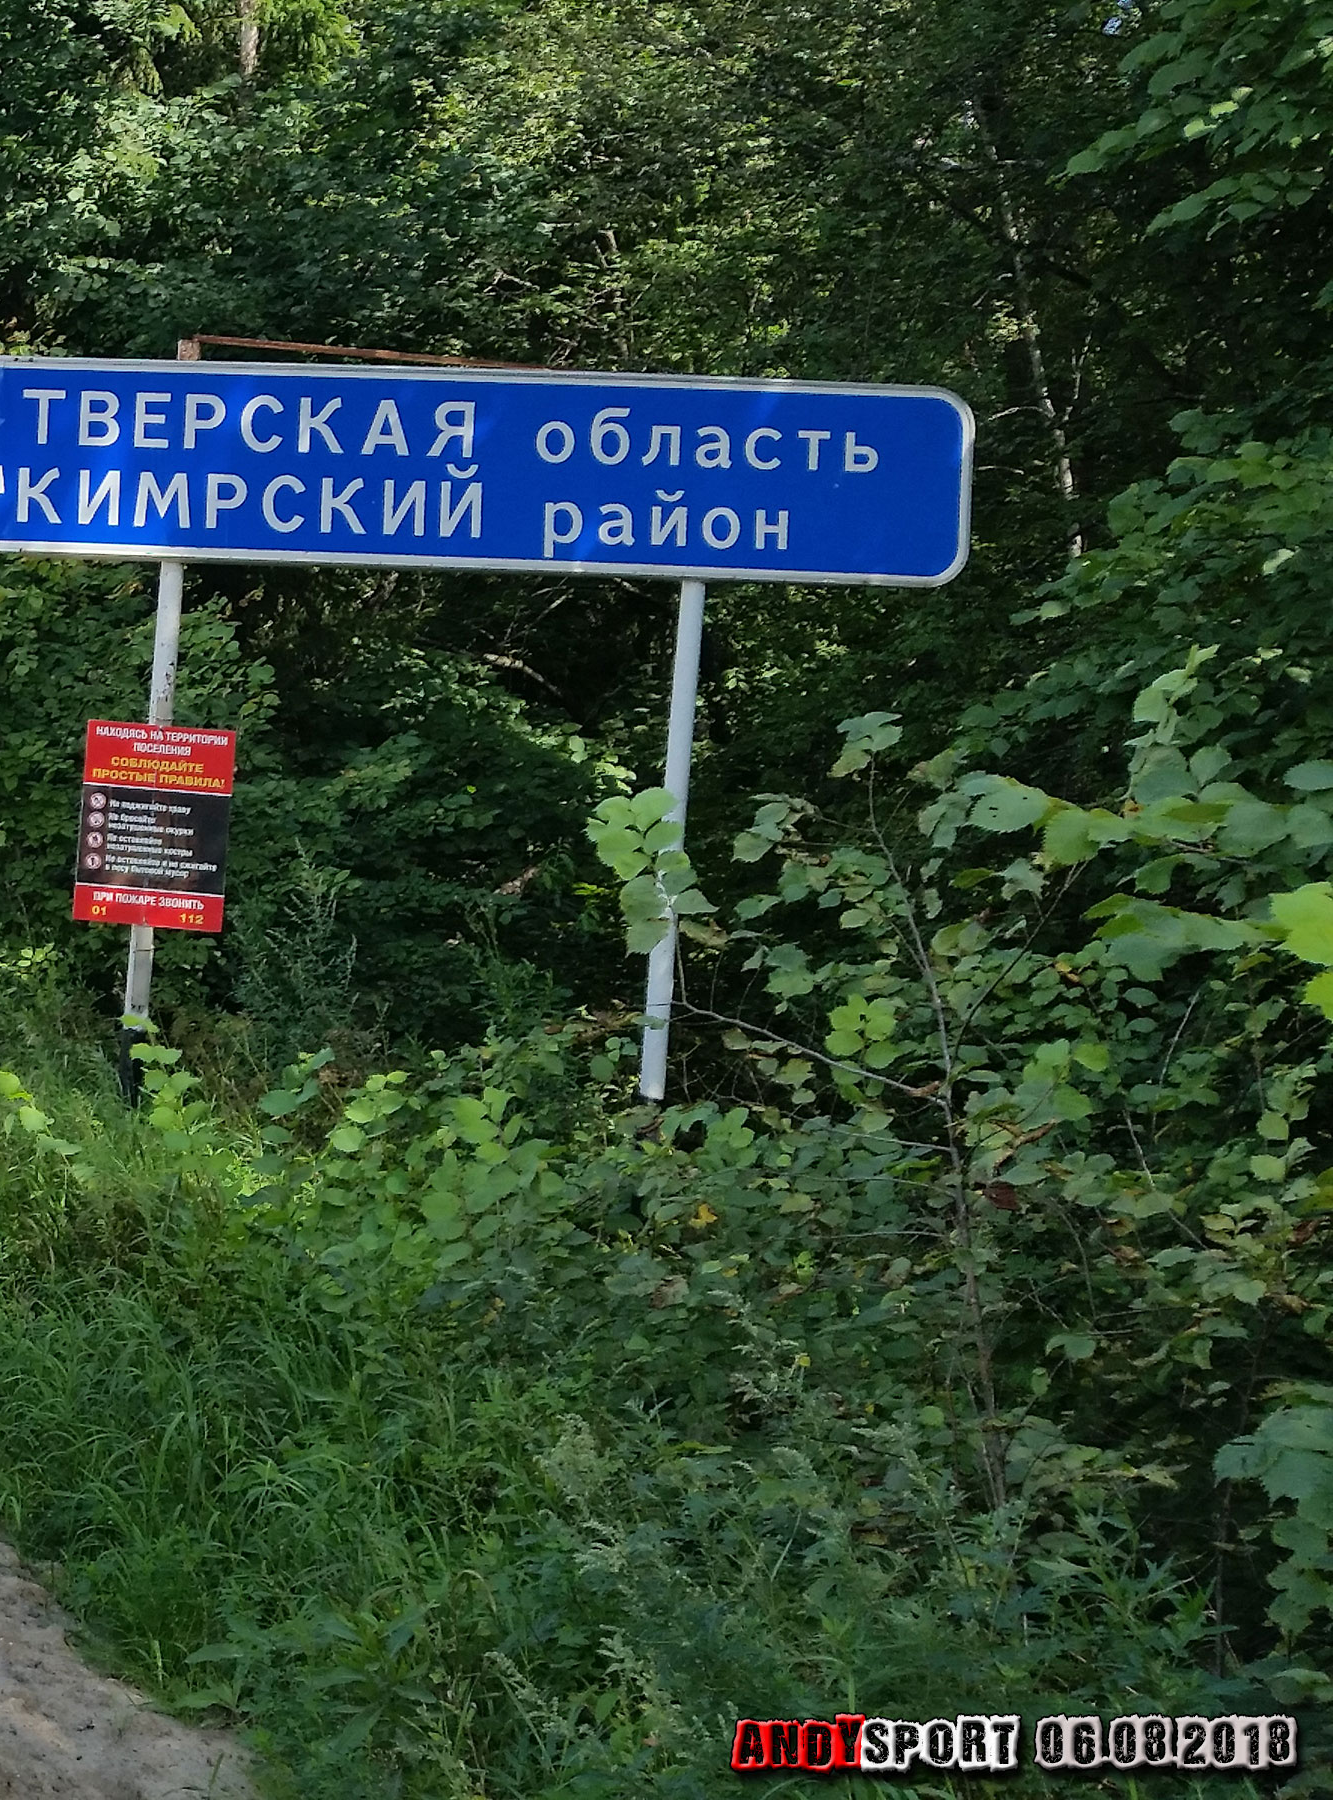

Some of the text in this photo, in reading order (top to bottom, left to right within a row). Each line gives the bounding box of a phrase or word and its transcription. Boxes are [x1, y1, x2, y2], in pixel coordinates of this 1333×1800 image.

[22, 387, 880, 474] ТВЕРСКАЯ область
[15, 464, 792, 558] КИМРСКИЙ район
[96, 725, 228, 746] НАХОДЯСЬ НА ТЕРРИТОРИИ
[133, 742, 191, 756] ПОСЕЛЕНИЯ
[111, 756, 204, 773] СОБЛЮДАЙТЕ
[92, 768, 225, 789] ПРОСТЫЕ ПРАВИЛА!
[93, 890, 205, 911] ПРИ ПОЖАРЕ ЗВОНИТЬ
[91, 905, 204, 925] 01 112
